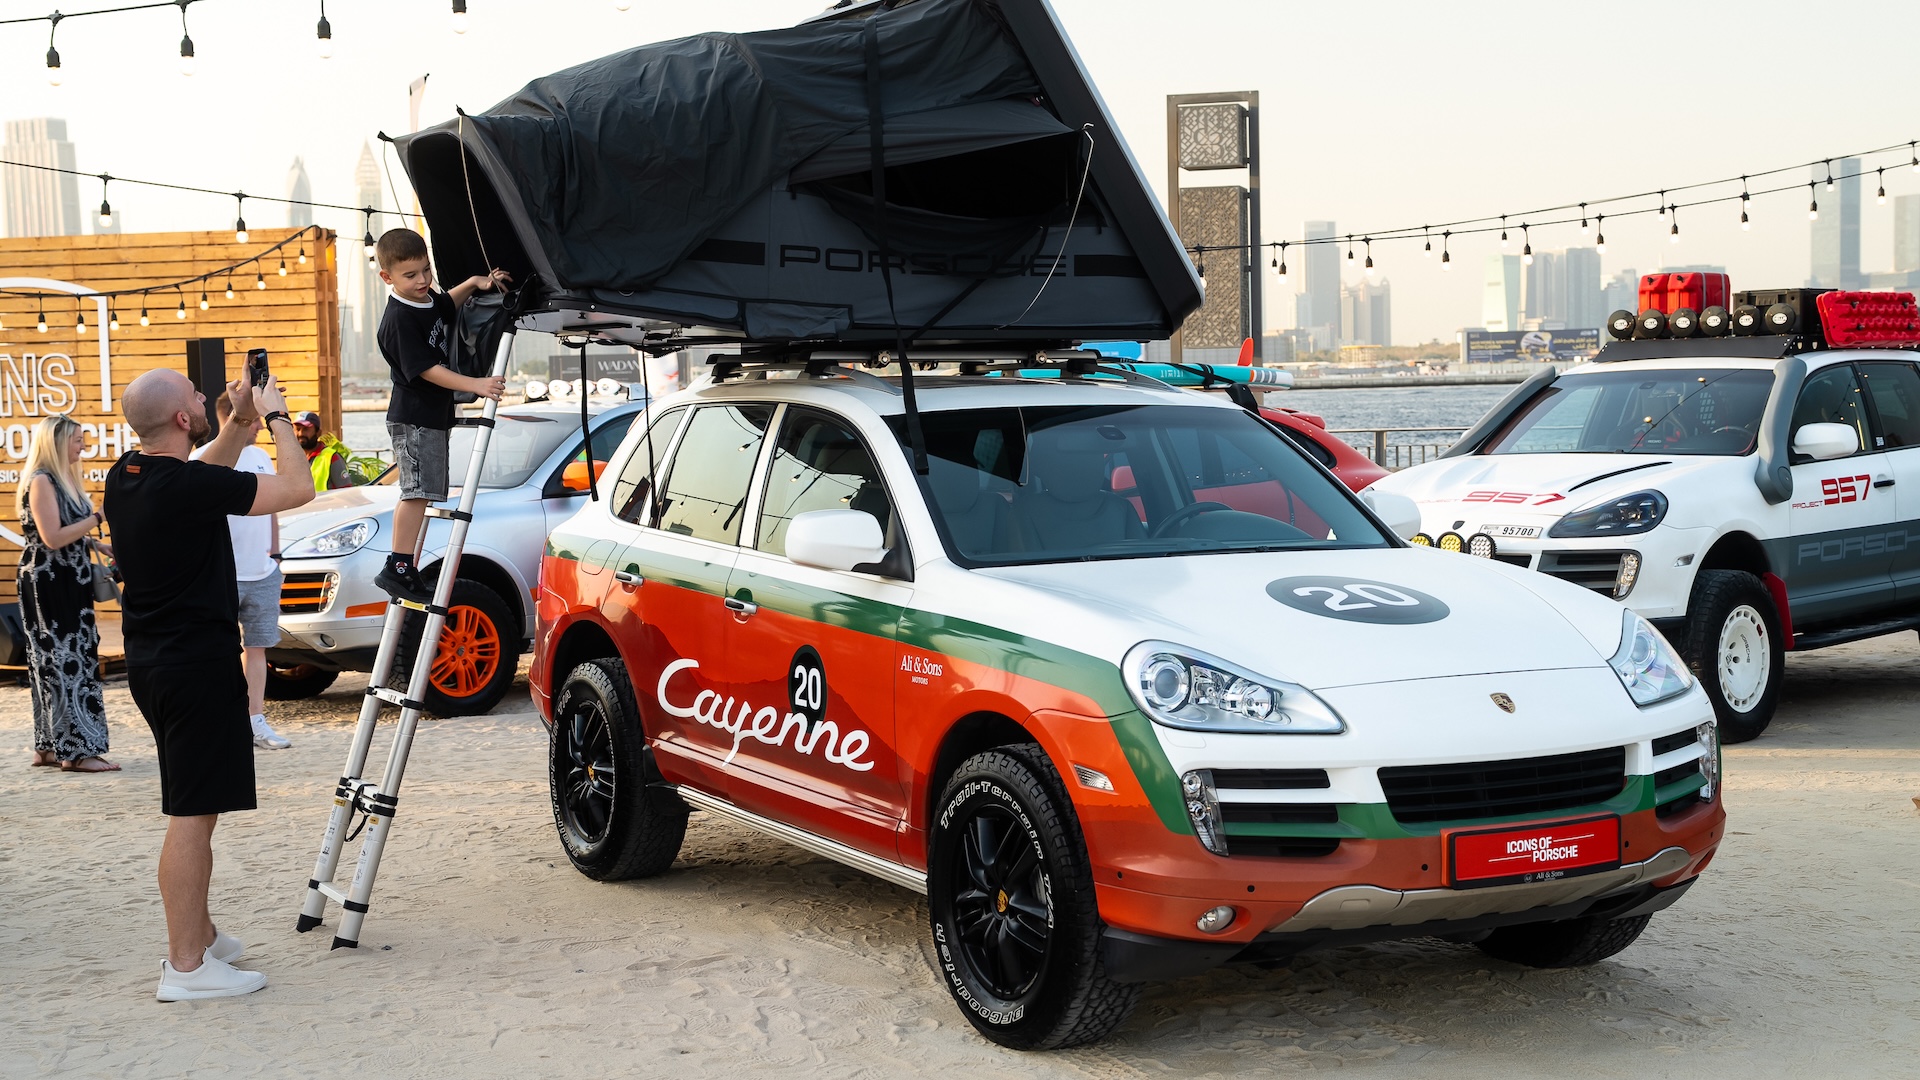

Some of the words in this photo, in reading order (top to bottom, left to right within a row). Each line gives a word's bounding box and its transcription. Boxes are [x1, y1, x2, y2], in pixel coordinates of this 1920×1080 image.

[779, 244, 1067, 277] PORSCHE
[1461, 491, 1567, 505] 957
[1791, 500, 1823, 510] PROJECT
[1820, 474, 1871, 505] 957
[1502, 526, 1535, 536] 95700
[1292, 583, 1420, 612] 20
[901, 655, 913, 672] Ali
[913, 657, 922, 674] &
[922, 658, 943, 677] Sons
[794, 665, 822, 710] 20
[911, 676, 929, 685] MOTORS
[657, 658, 875, 771] Cayenne
[940, 781, 1044, 860] Trail-Terrain
[1506, 838, 1538, 854] ICONS
[1538, 836, 1552, 850] OF
[1533, 845, 1578, 863] PORSCHE
[1536, 872, 1545, 880] Ali
[1550, 870, 1564, 878] Sons
